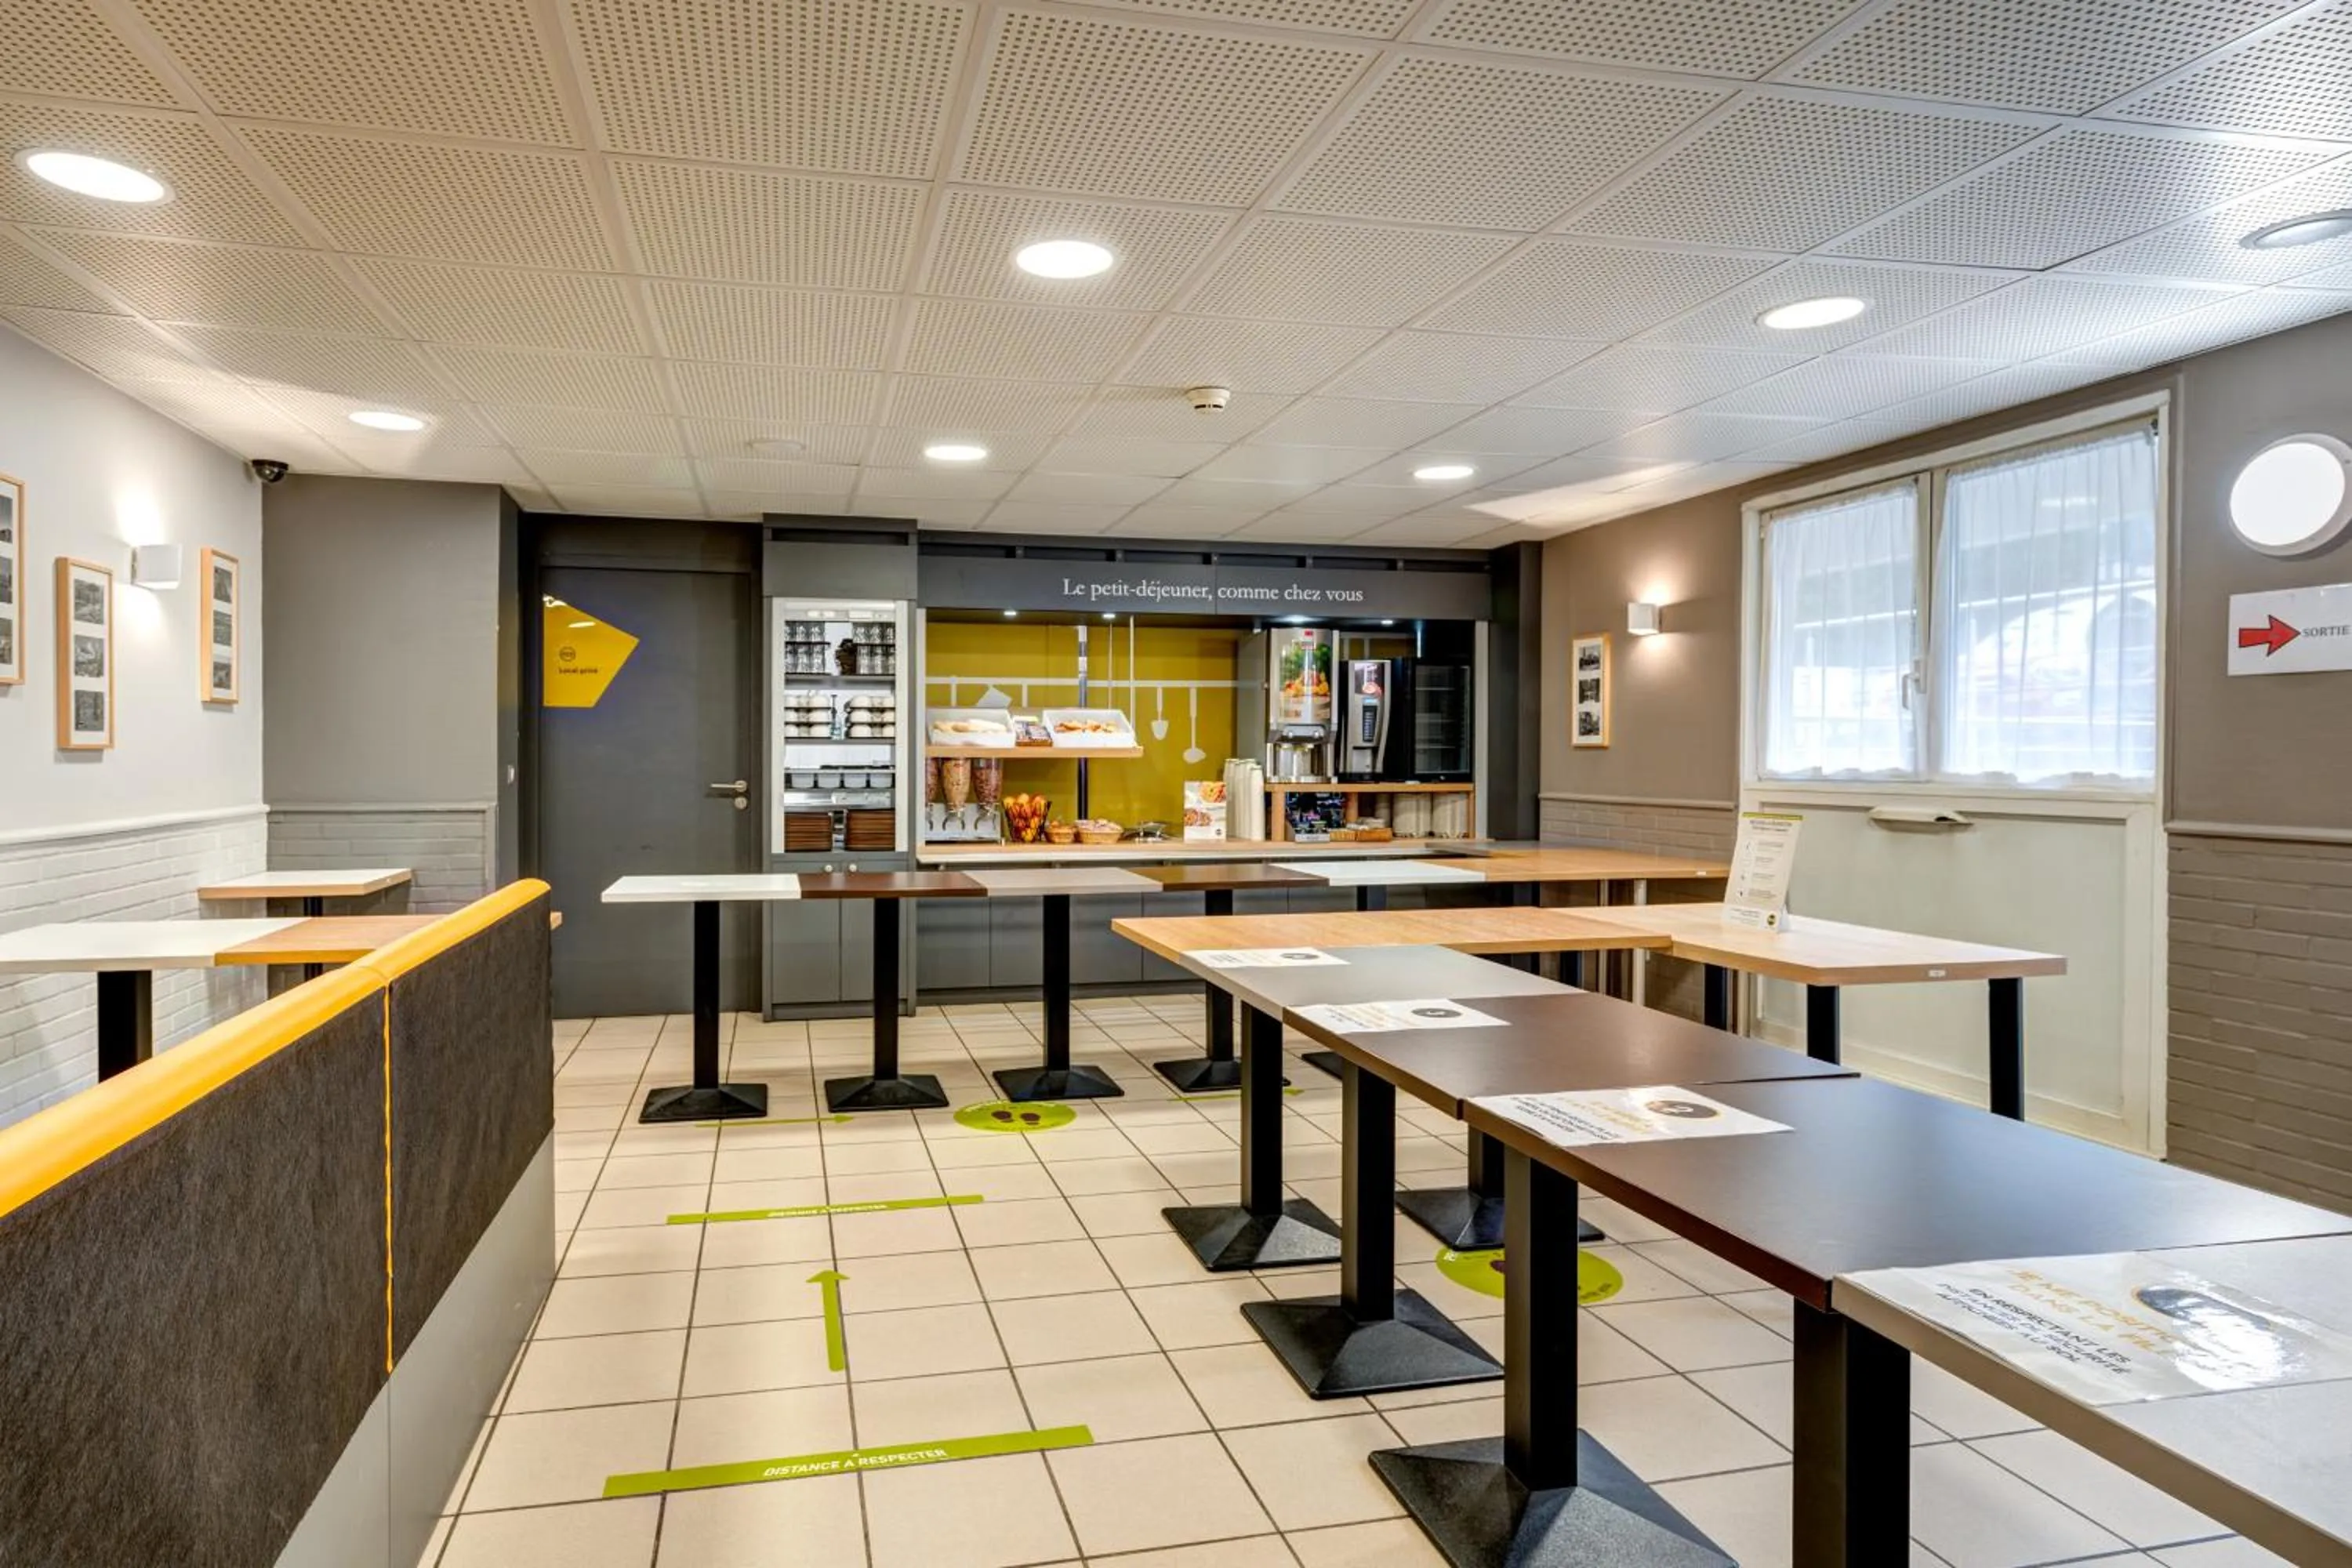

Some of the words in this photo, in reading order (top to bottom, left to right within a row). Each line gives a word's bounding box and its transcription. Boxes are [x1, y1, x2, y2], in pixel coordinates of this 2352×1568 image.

[1063, 579, 1086, 596] Le
[1091, 579, 1213, 602] petit-déjeuner,
[1218, 586, 1279, 601] comme
[1283, 583, 1322, 601] chez
[1325, 588, 1364, 602] vous
[2303, 625, 2351, 637] SORTIE
[1990, 1298, 2100, 1346] RESPECTANT
[764, 1461, 840, 1476] DISTANCE
[858, 1448, 947, 1465] RESPECTER
